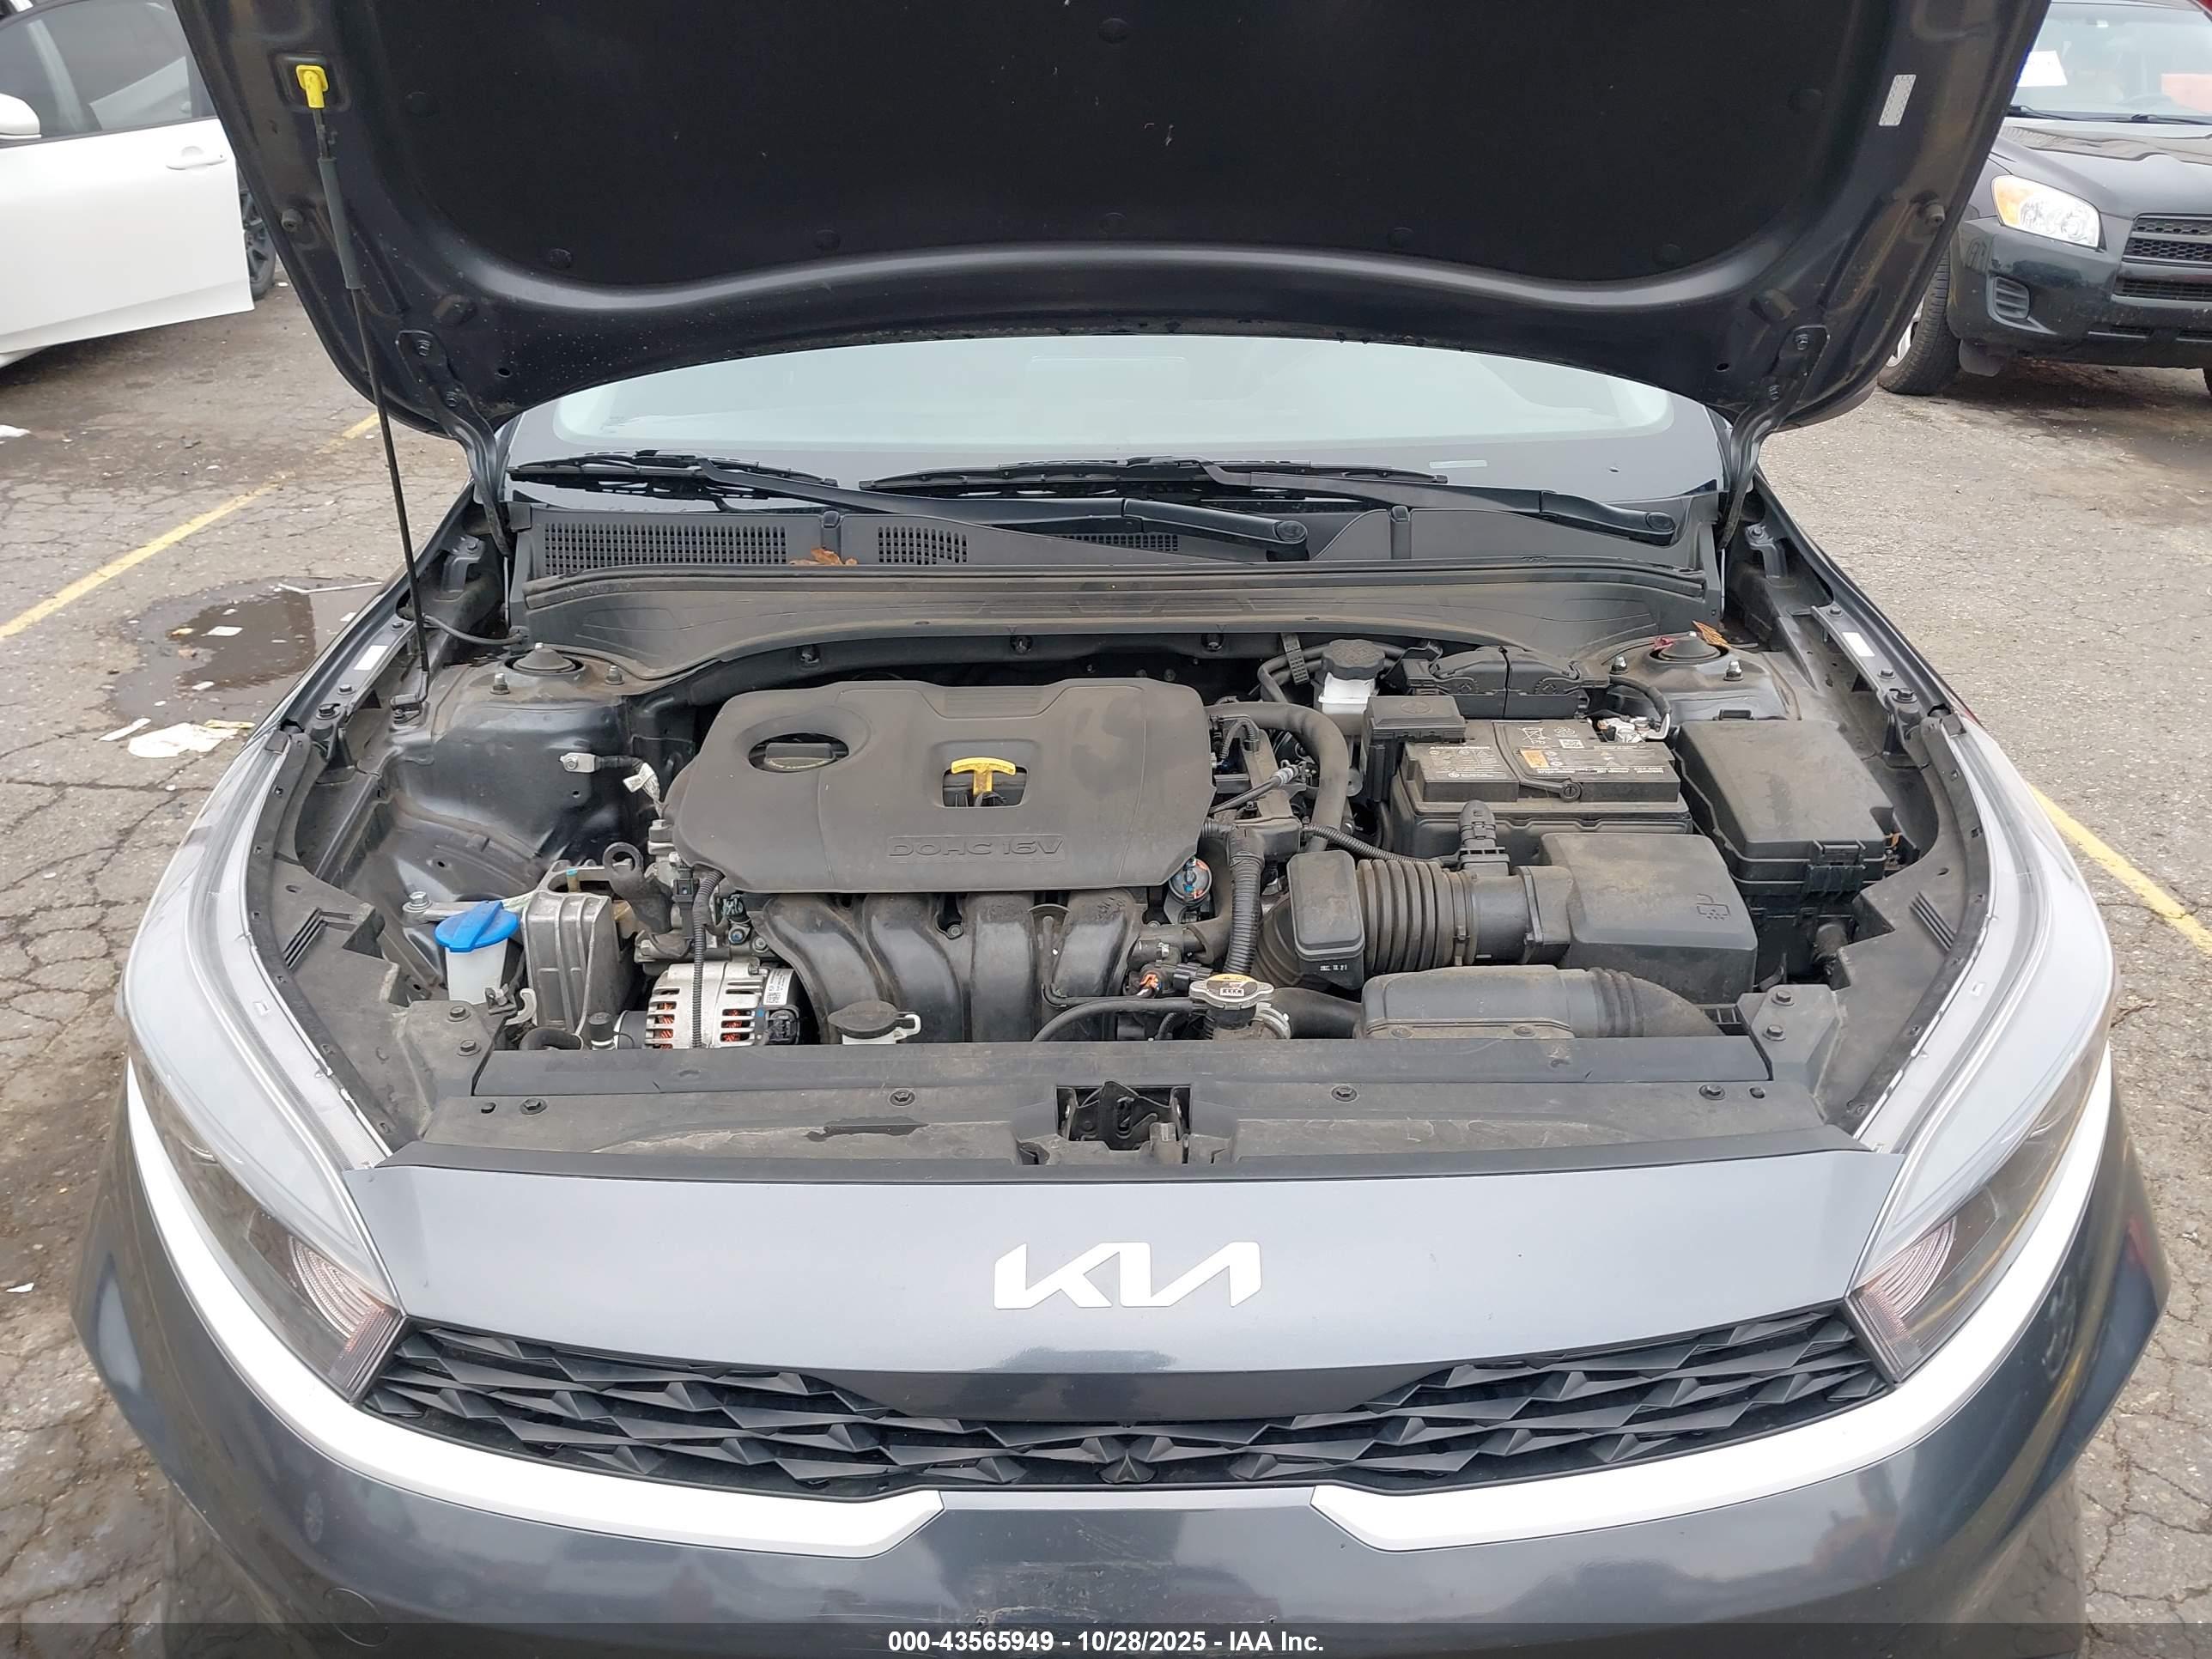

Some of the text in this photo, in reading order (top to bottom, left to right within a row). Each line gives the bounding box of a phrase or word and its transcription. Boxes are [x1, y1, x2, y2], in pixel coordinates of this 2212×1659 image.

[889, 837, 1064, 857] DOHC 16V
[994, 1241, 1262, 1310] KIA
